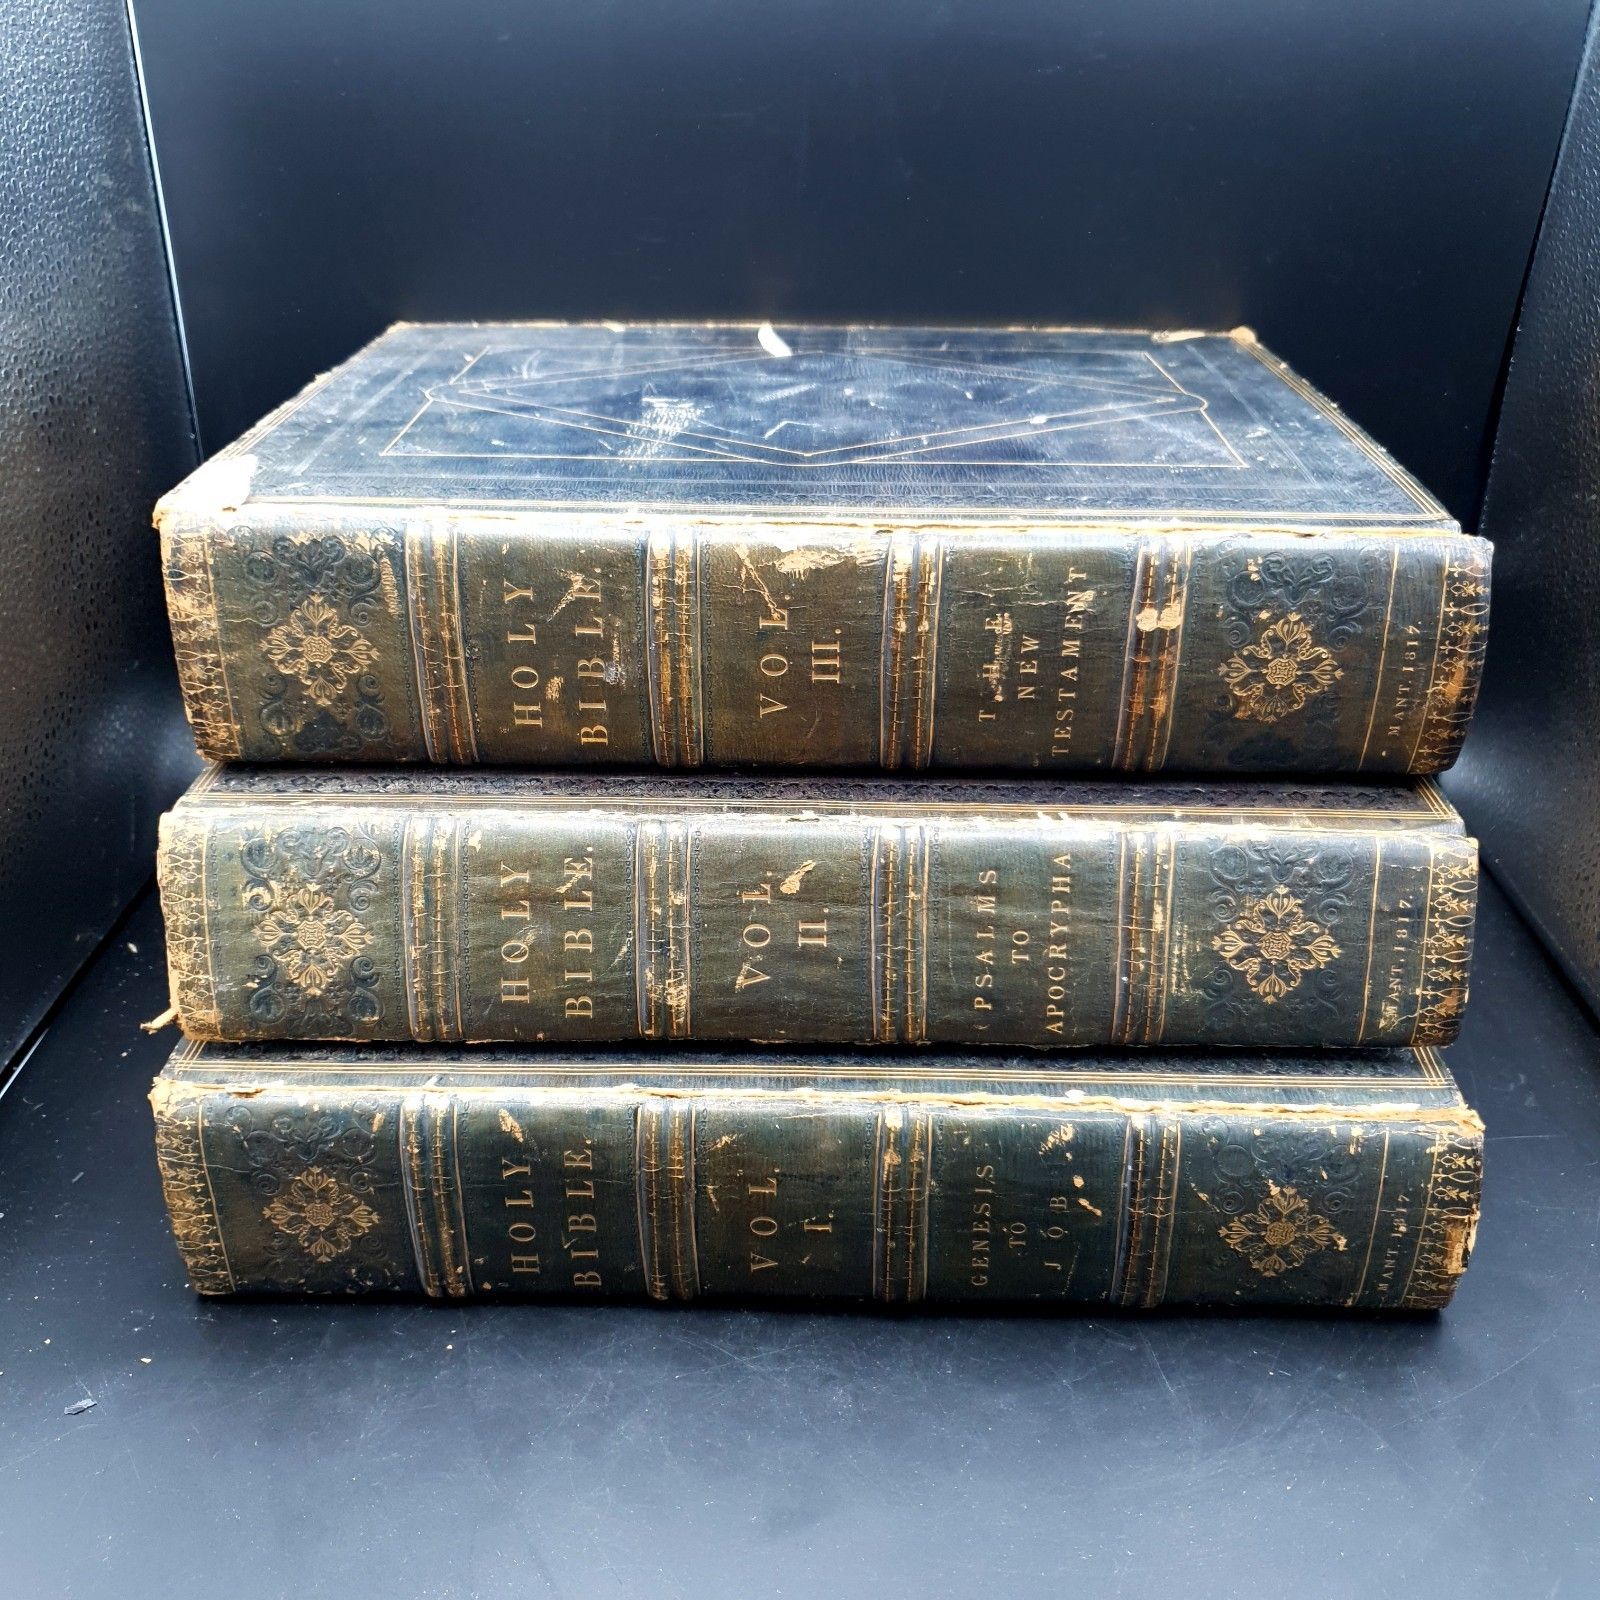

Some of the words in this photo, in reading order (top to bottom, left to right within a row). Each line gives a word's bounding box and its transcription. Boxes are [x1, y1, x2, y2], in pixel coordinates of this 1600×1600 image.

[503, 578, 543, 728] HOLY
[811, 628, 842, 683] III.
[1018, 634, 1039, 699] NEW
[1052, 567, 1087, 756] TESTAMENT
[500, 859, 530, 1004] HOLY
[564, 846, 593, 1018] BIBLE.
[741, 870, 772, 988] VOL.
[798, 907, 829, 947] II.
[974, 869, 997, 1010] PSALMS
[1011, 930, 1029, 964] TO
[1045, 852, 1071, 1034] APOCRYPHA
[501, 1156, 540, 1274] HOLY
[563, 1138, 602, 1286] BIBLE.
[748, 1167, 780, 1272] VOL.
[971, 1164, 994, 1285] GENESIS
[1008, 1222, 1027, 1248] TO
[1044, 1196, 1067, 1270] JOB
